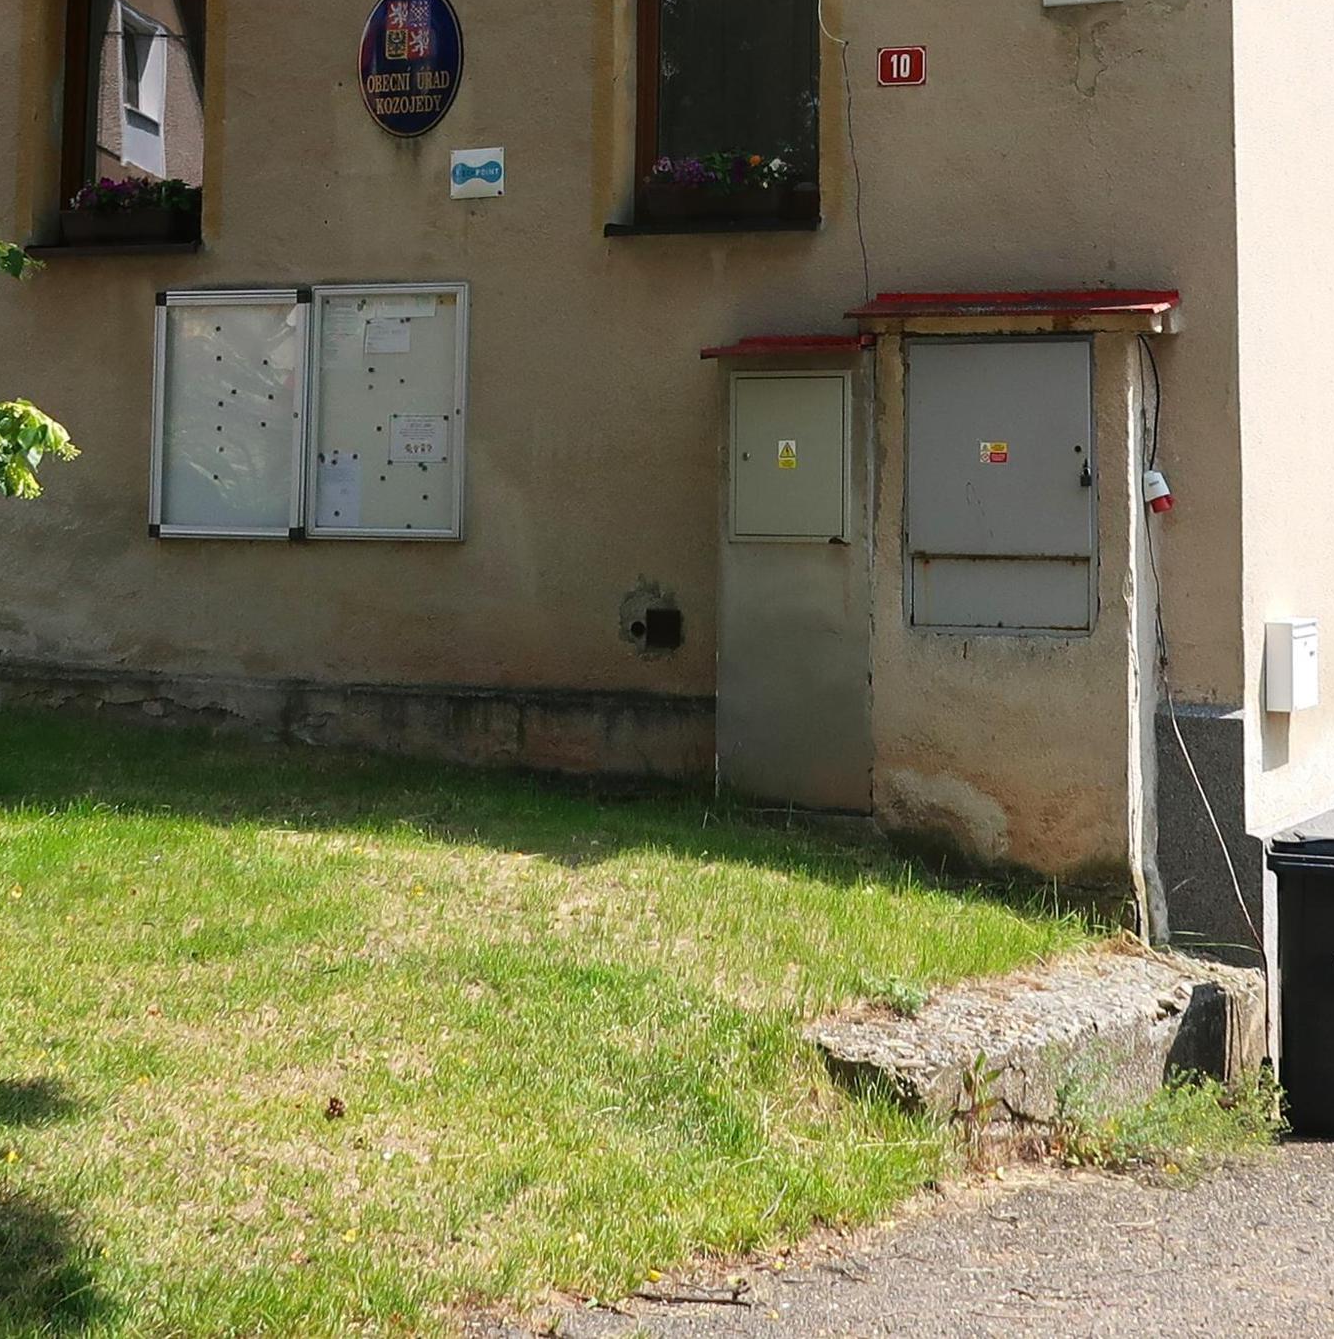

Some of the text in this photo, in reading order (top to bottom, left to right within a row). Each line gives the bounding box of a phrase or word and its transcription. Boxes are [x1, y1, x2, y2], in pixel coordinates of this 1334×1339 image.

[890, 53, 910, 78] 10
[367, 66, 411, 93] OBECNÍ
[375, 94, 442, 115] KOZOJEDY
